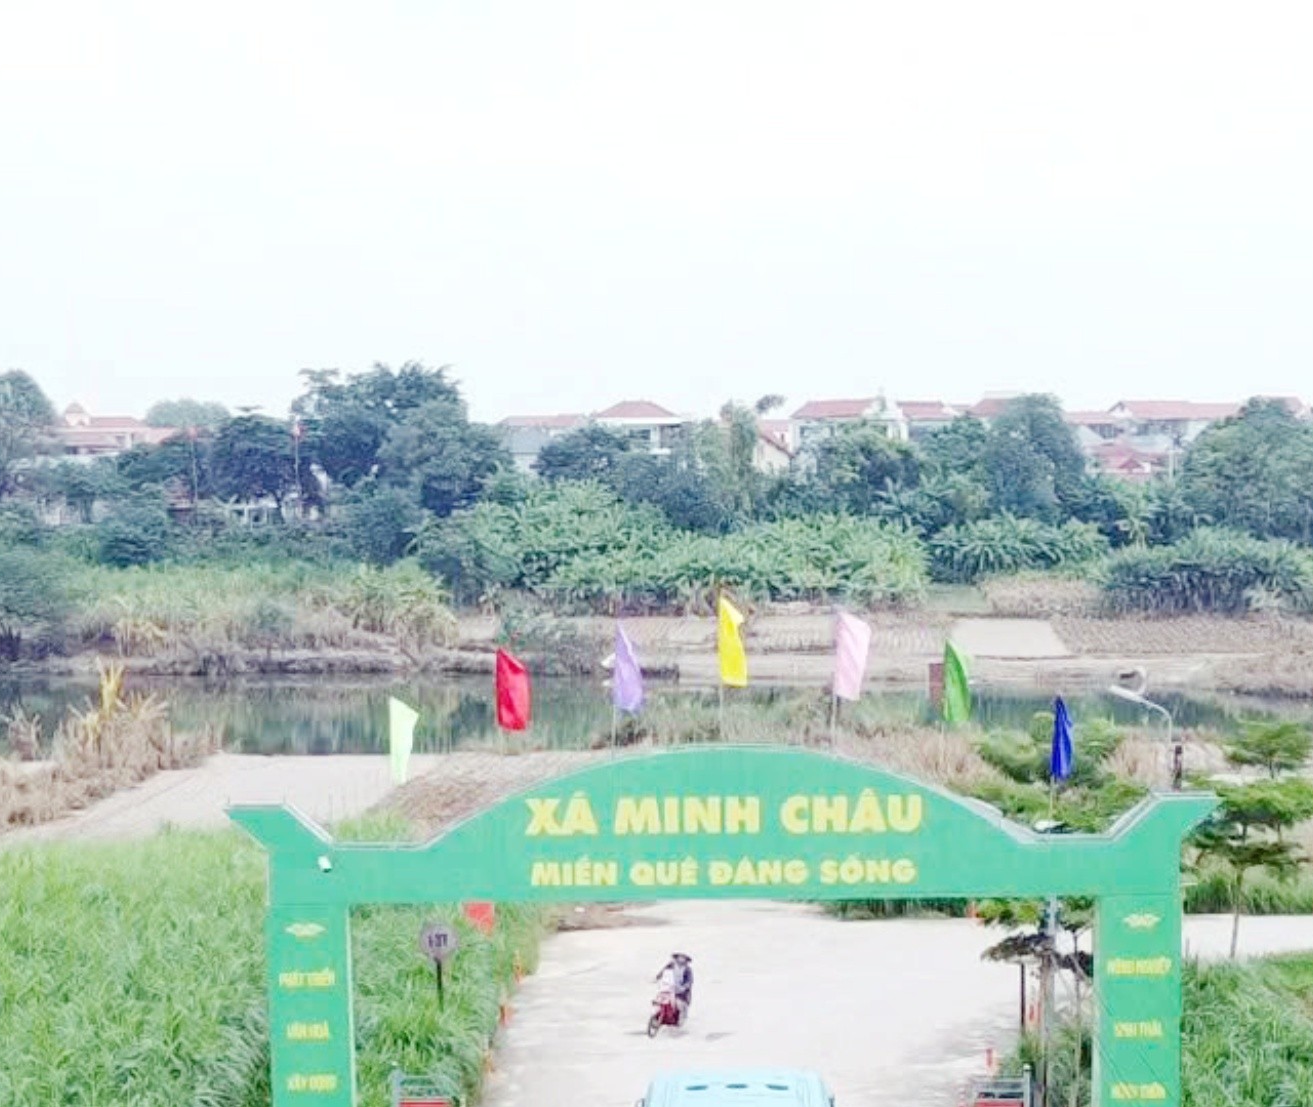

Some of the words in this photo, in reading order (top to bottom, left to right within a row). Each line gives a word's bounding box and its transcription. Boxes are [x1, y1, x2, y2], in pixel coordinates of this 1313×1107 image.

[615, 795, 761, 835] MINH
[780, 788, 923, 834] CHÂU
[630, 855, 699, 887] QUÊ
